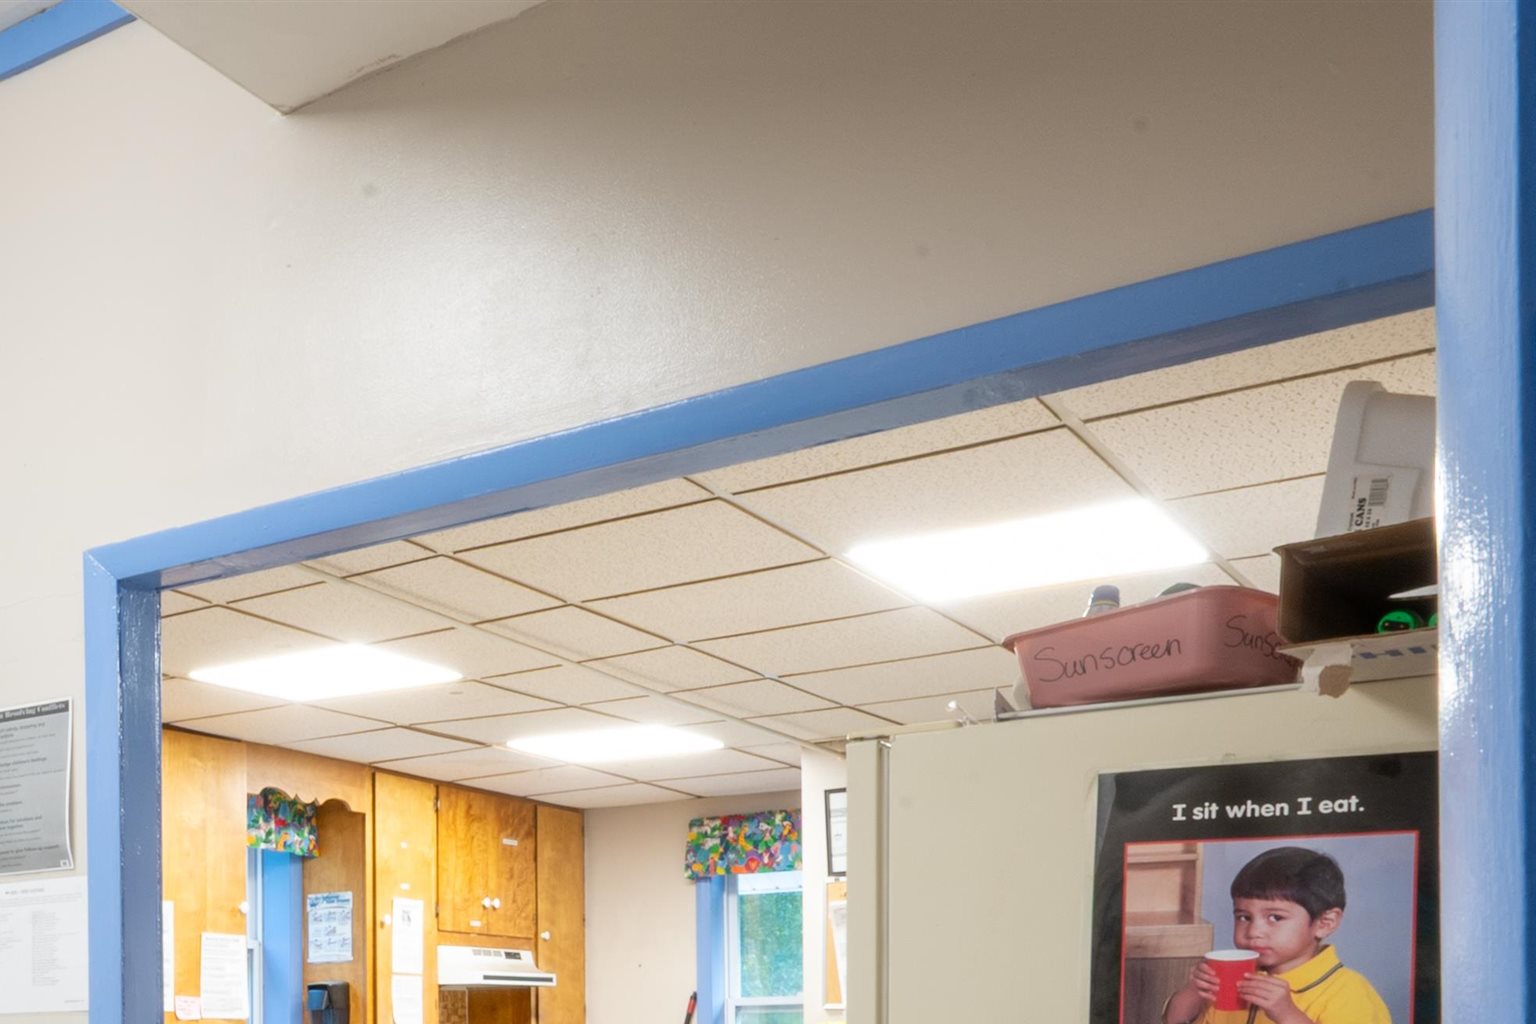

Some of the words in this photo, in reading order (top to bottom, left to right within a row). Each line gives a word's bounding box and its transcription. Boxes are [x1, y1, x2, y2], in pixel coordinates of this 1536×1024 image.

[1354, 497, 1366, 527] CANS
[1034, 638, 1182, 682] Sunscreen
[1172, 804, 1187, 821] I
[1192, 802, 1219, 820] sit
[1225, 800, 1290, 818] when
[1296, 797, 1313, 815] I
[1318, 796, 1365, 814] eat.
